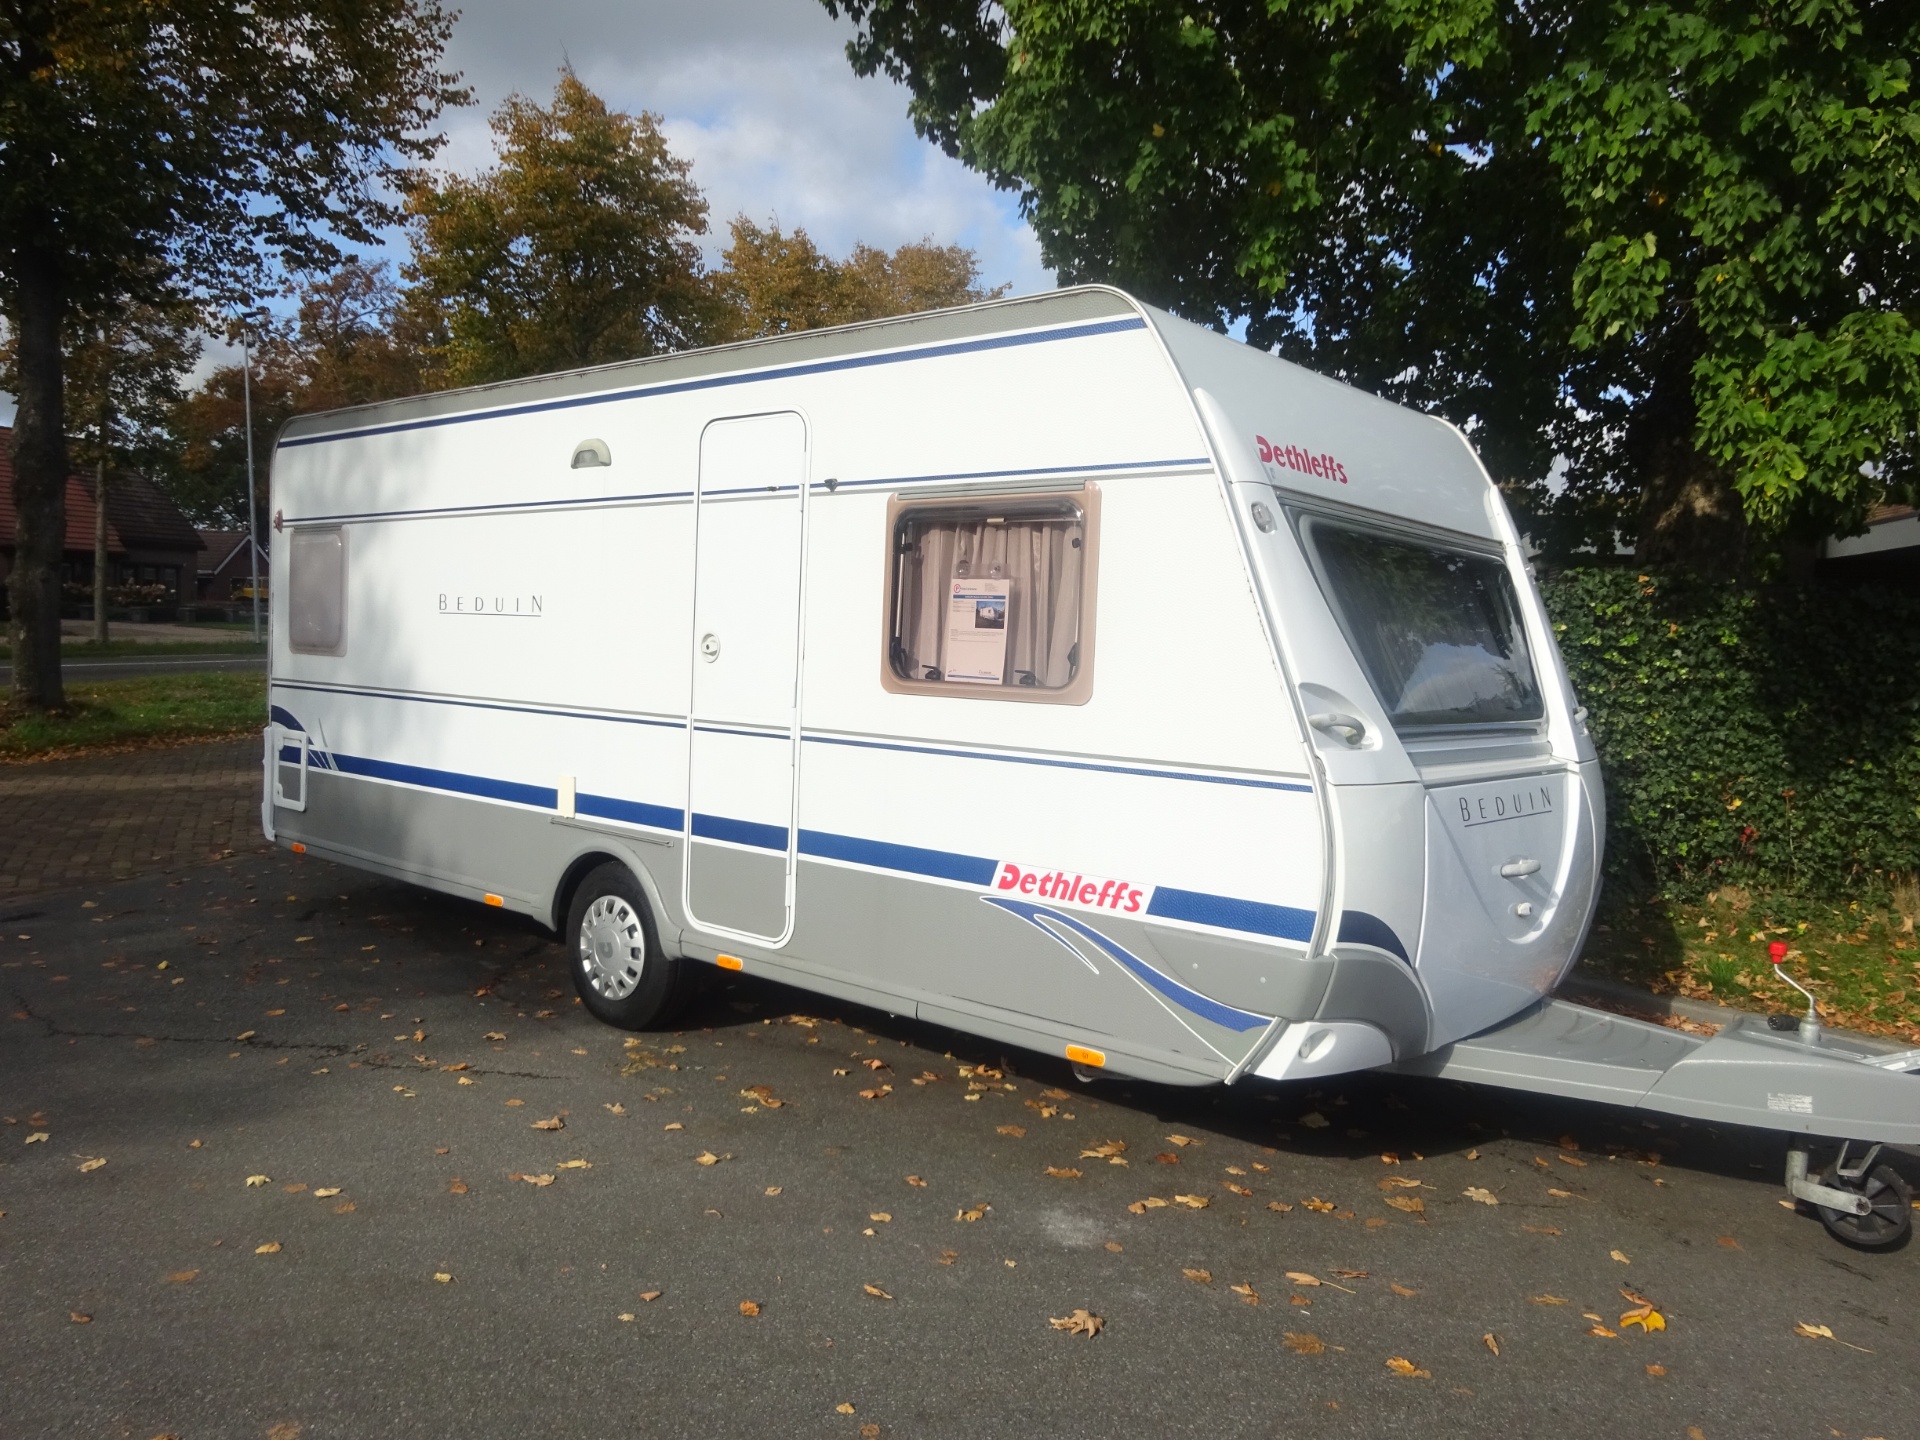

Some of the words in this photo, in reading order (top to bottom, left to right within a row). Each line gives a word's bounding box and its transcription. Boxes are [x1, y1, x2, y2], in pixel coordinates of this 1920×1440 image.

[1255, 434, 1348, 485] Dethleffs
[438, 593, 543, 613] BEDUIN
[1459, 786, 1552, 822] BEDUIN
[997, 863, 1144, 913] Dethleffs
